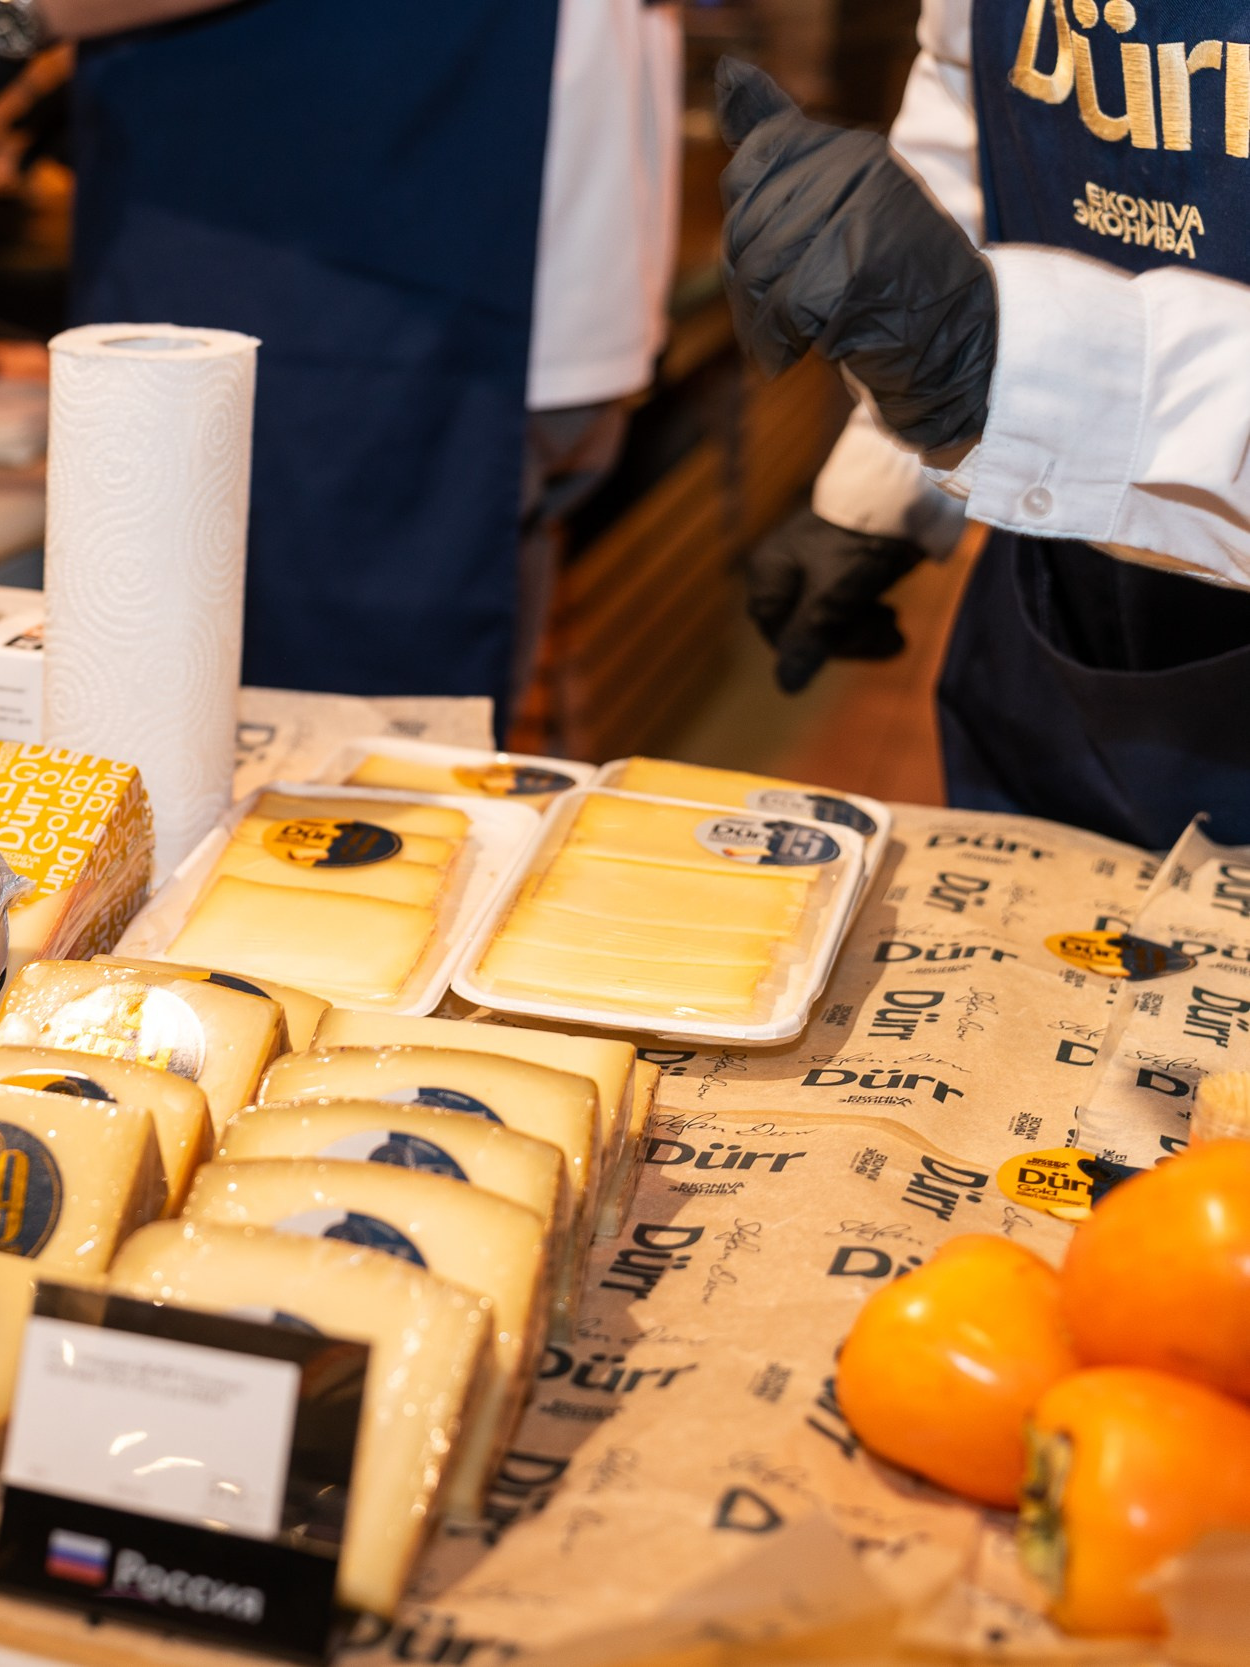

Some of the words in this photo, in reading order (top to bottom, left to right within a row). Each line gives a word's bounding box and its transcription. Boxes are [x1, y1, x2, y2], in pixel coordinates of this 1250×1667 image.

[1073, 198, 1197, 259] ЭКОНИВА
[1085, 181, 1205, 236] EKONIVA
[10, 760, 99, 791] Gold
[28, 788, 83, 854] Gold
[39, 845, 86, 894] Dür
[872, 939, 1020, 964] Dürr
[868, 990, 946, 1041] Dürr
[1183, 985, 1250, 1049] Dürr
[801, 1068, 965, 1104] Dürr
[644, 1137, 808, 1173] Dürr
[680, 1181, 746, 1191] EKONIVA
[901, 1155, 990, 1223] Dürr
[1017, 1184, 1058, 1198] Gold
[600, 1222, 706, 1300] Dürr
[112, 1546, 266, 1625] Россия
